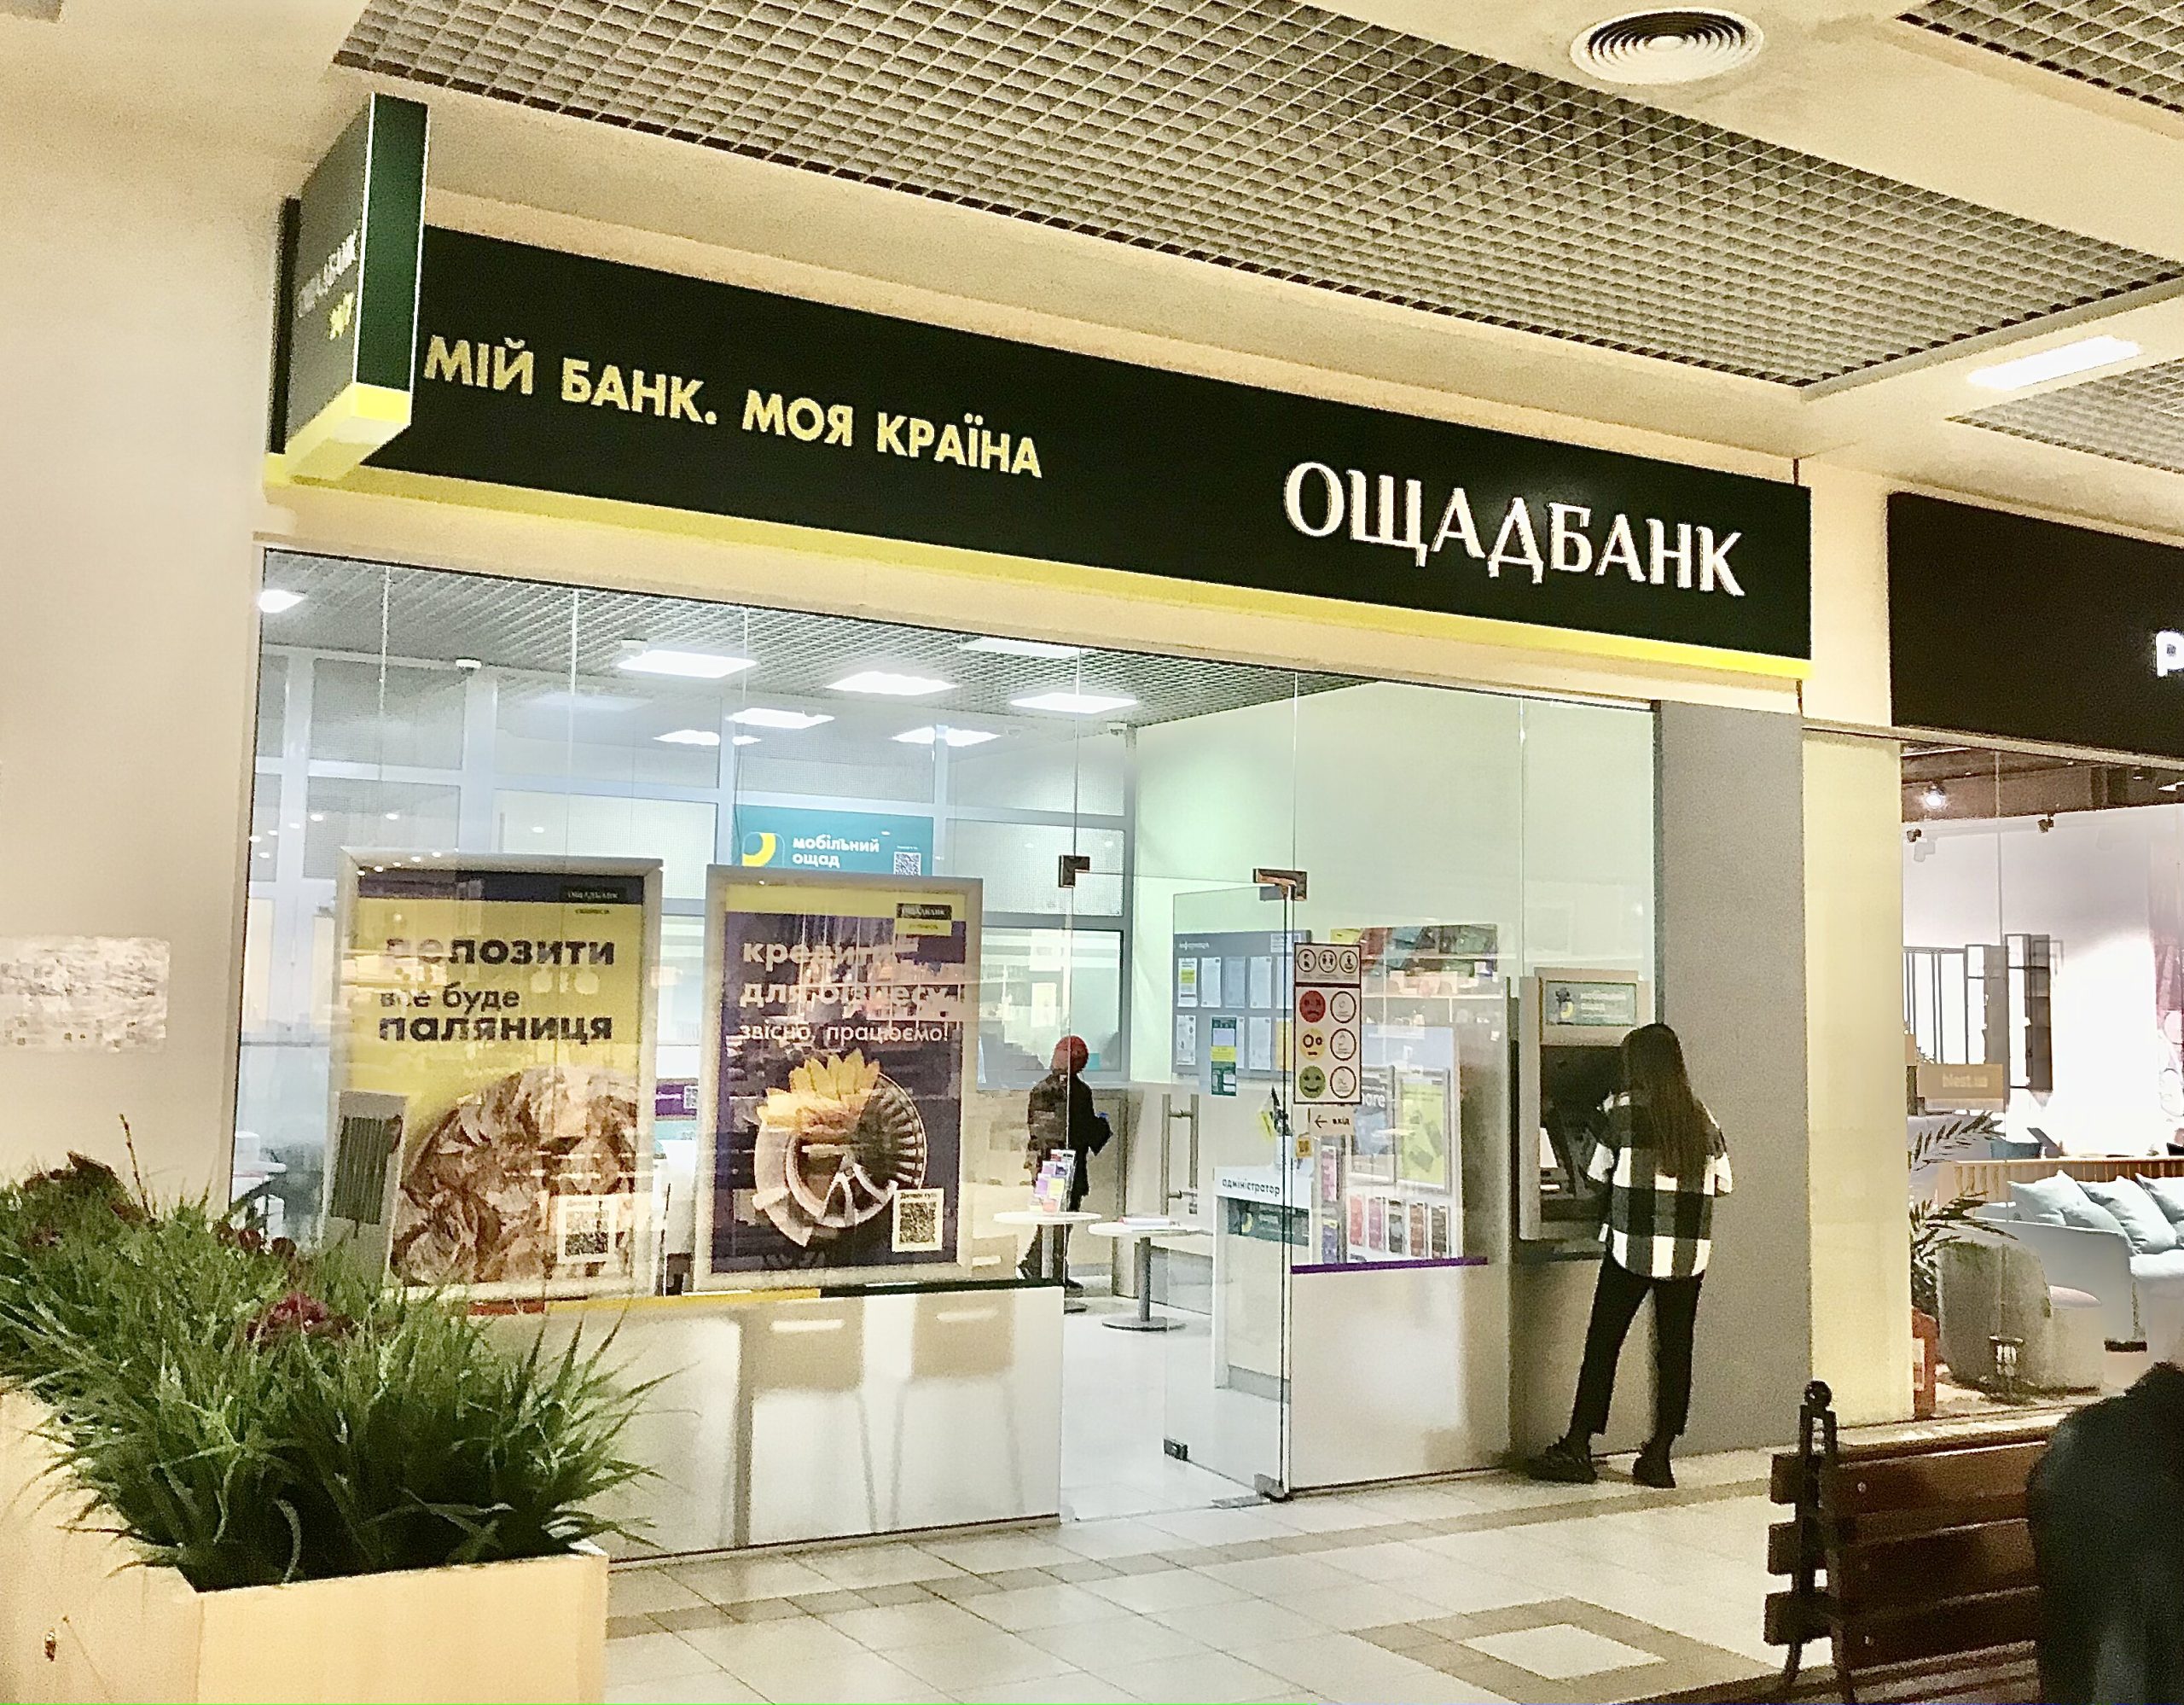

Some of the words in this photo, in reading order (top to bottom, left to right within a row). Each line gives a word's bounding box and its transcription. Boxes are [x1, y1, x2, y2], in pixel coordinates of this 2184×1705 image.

[424, 335, 534, 395] МІЙ
[561, 357, 717, 425] БАНК.
[741, 389, 854, 447] МОЯ
[876, 412, 1043, 478] КРАЇНА
[1283, 461, 1746, 597] ОЩАДБАНК
[793, 833, 880, 853] мобільний
[792, 853, 840, 868] ощад
[743, 943, 896, 972] кредит
[380, 991, 431, 1008] ве
[442, 981, 520, 1015] буде
[379, 1016, 613, 1045] паляниця
[1222, 1178, 1281, 1197] адміністратор
